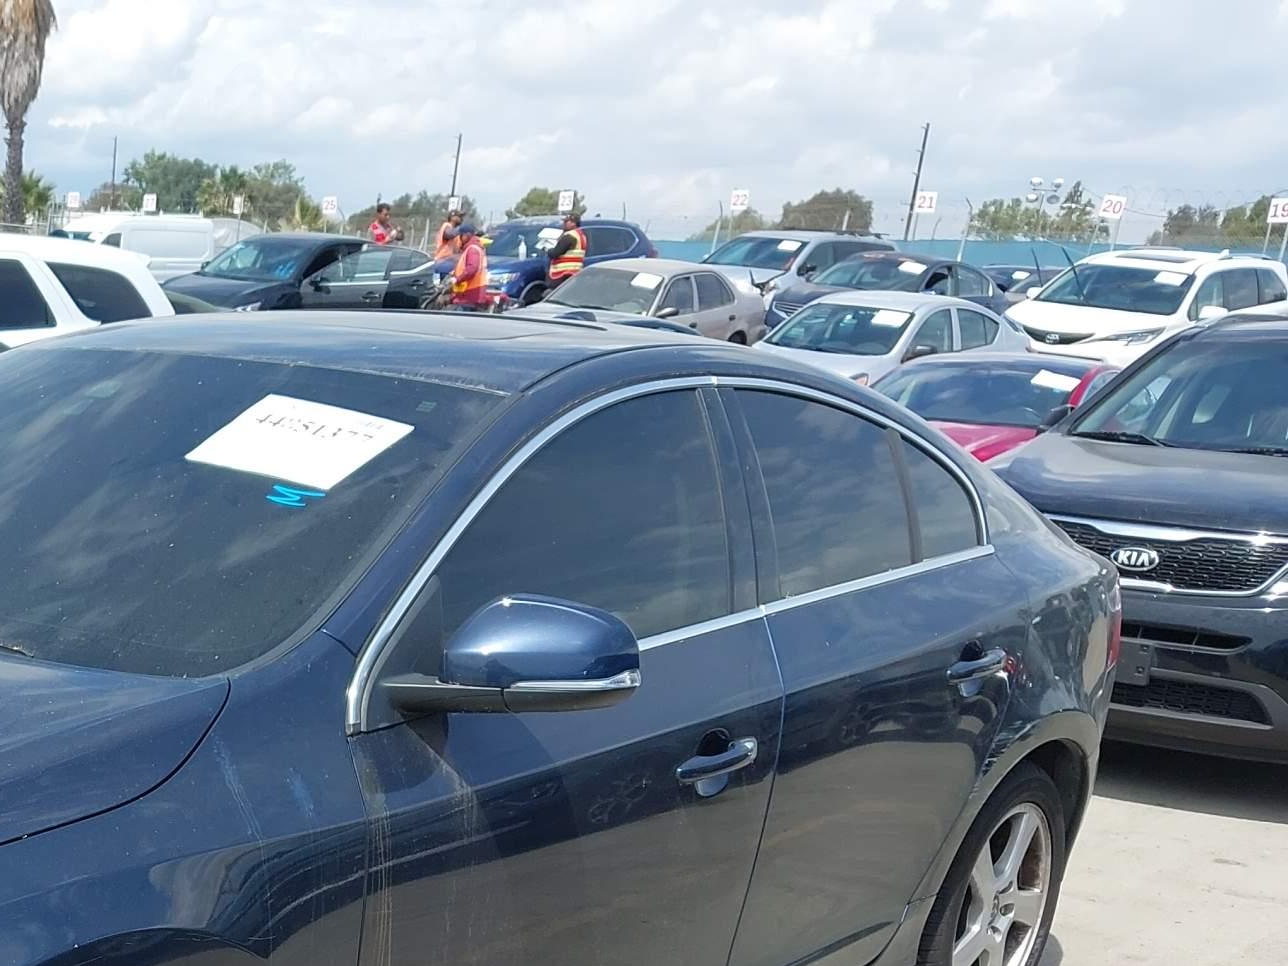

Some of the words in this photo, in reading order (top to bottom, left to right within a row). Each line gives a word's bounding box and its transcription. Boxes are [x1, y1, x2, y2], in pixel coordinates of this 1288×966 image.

[732, 193, 748, 207] 22
[918, 195, 934, 209] 21
[1102, 199, 1122, 215] 20
[1270, 203, 1288, 218] 19
[1117, 550, 1150, 567] KIA
